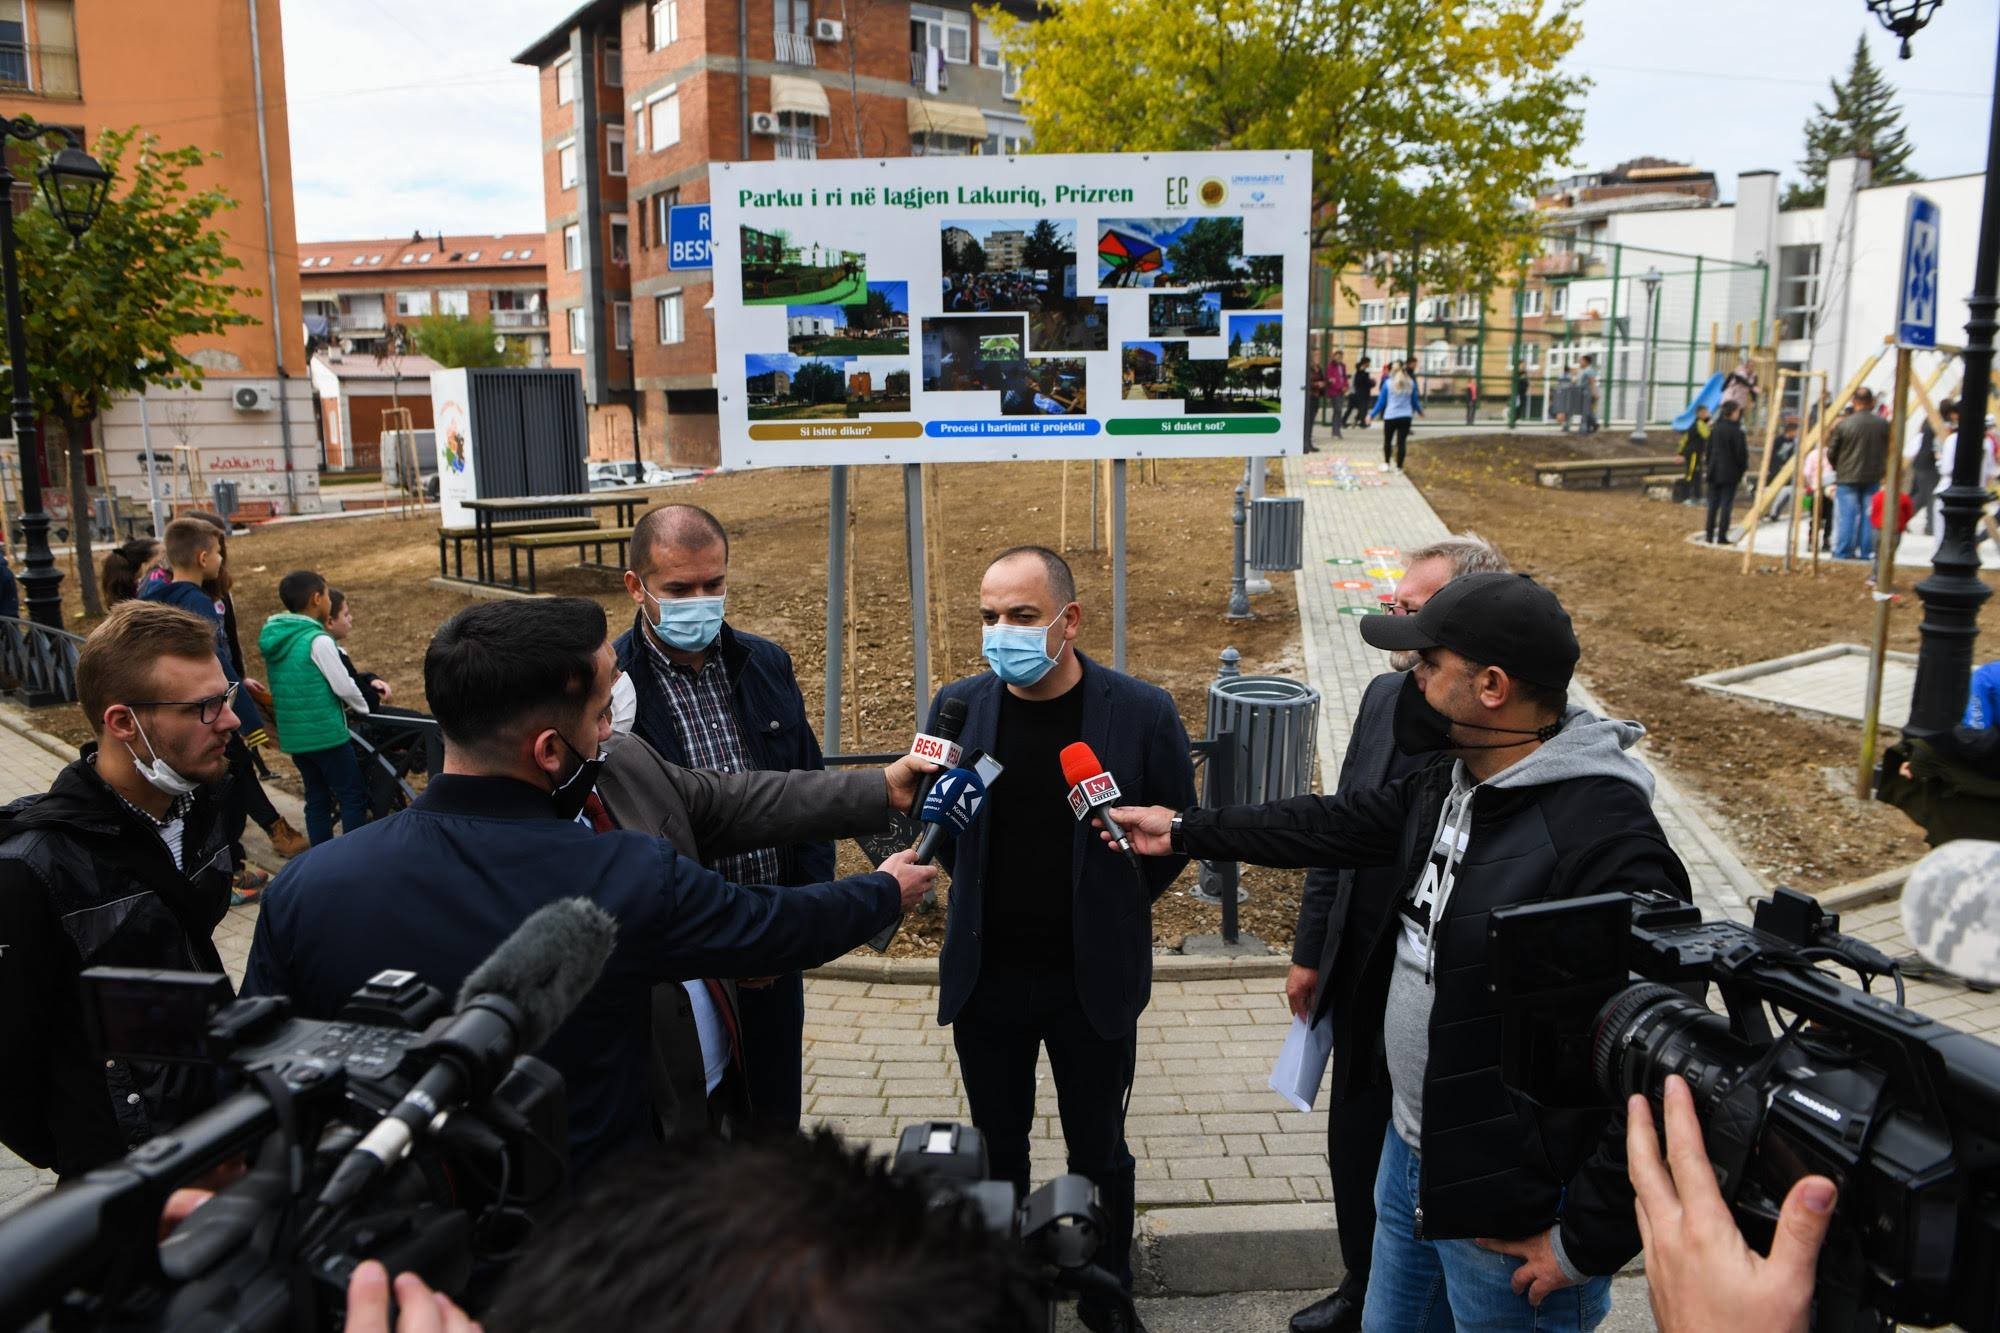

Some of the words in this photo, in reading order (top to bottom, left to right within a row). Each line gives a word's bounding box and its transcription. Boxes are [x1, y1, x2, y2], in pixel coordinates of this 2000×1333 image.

[739, 189, 804, 208] Parku
[811, 188, 818, 207] i
[825, 188, 843, 207] ri
[850, 187, 877, 206] në
[884, 186, 950, 209] lagjen
[957, 185, 1047, 208] Lakuriq,
[1055, 184, 1134, 204] Prizren
[1166, 175, 1189, 206] EC
[800, 426, 810, 436] Si
[812, 426, 837, 436] ishte
[840, 426, 872, 436] dikur?
[940, 423, 978, 433] Procesi
[981, 423, 985, 432] i
[987, 422, 1028, 432] hartimit
[1030, 422, 1040, 432] të
[1042, 422, 1085, 434] projektit
[1161, 421, 1171, 431] Si
[1173, 421, 1202, 431] duket
[1204, 421, 1226, 431] sot?
[914, 738, 943, 760] BESA
[1090, 781, 1106, 792] tv
[951, 804, 970, 824] Kosova
[1788, 1089, 1842, 1122] Panasonic
